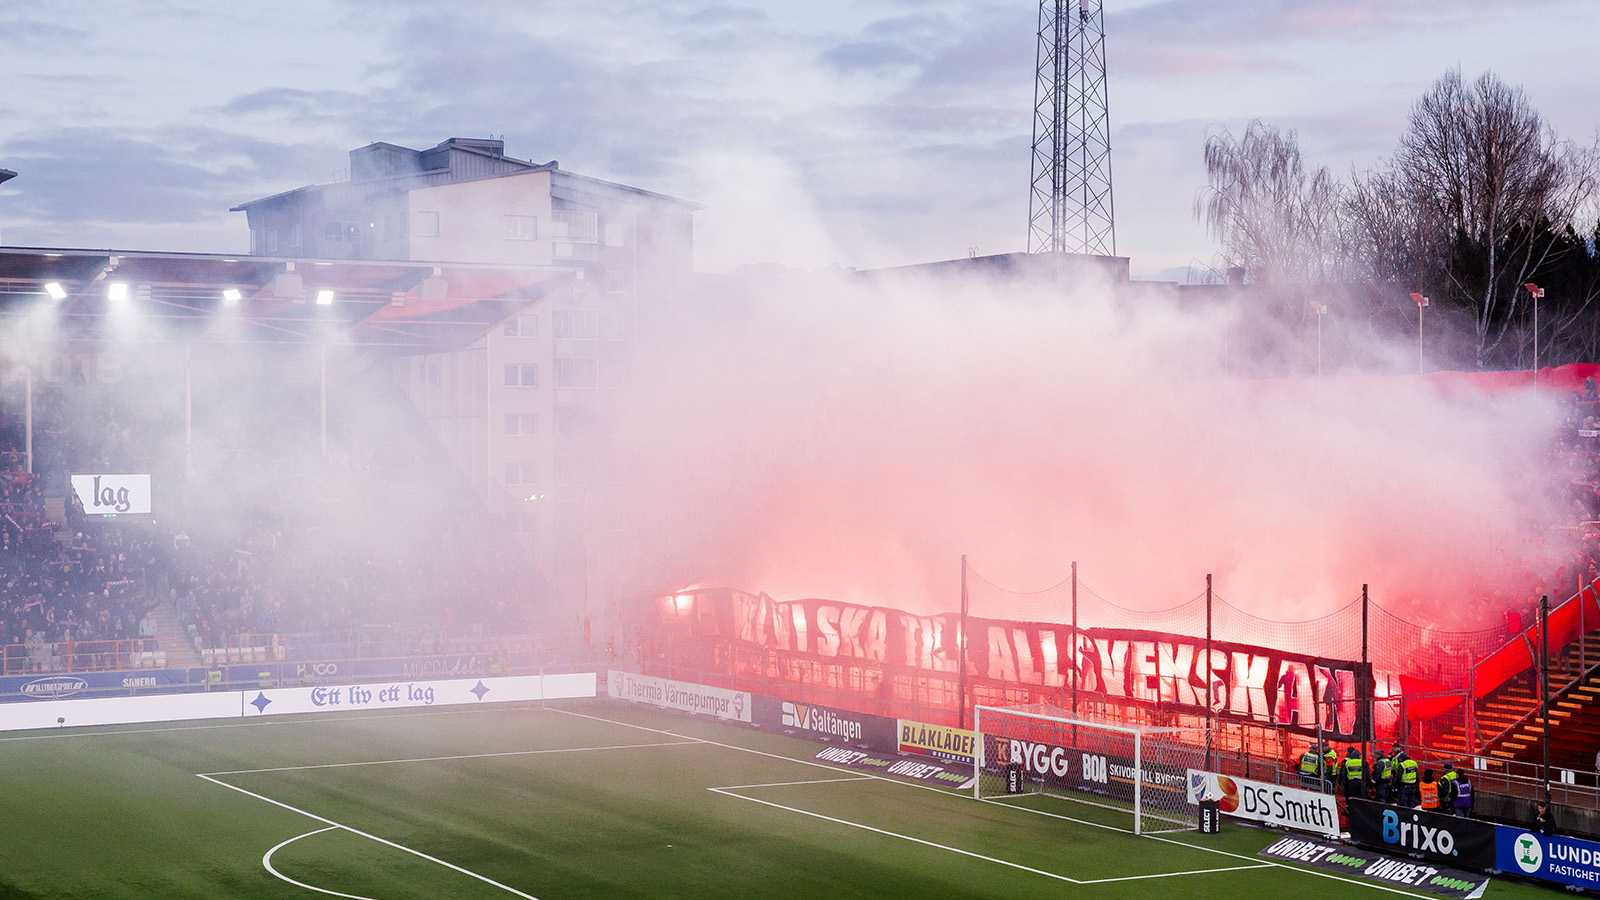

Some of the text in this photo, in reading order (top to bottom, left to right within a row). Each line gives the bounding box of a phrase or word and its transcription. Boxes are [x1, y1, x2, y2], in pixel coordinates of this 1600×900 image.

[93, 476, 130, 512] lag
[816, 605, 888, 659] SKA
[987, 625, 1357, 735] ALLSVENSKAN
[311, 683, 434, 706] Ett liv ett lag
[627, 677, 730, 715] Thermia Värmepumpar
[811, 707, 862, 743] Saltängen
[815, 746, 868, 765] UNIBET
[932, 751, 970, 763] WORKWEAR
[1082, 753, 1107, 784] BOA
[887, 760, 943, 780] UNIBET
[1244, 785, 1333, 828] DS Smith
[1266, 838, 1336, 863] UNIBET
[1549, 842, 1600, 867] LUNDB
[1364, 857, 1438, 885] UNIBET
[1549, 863, 1600, 882] FASTIGHET
